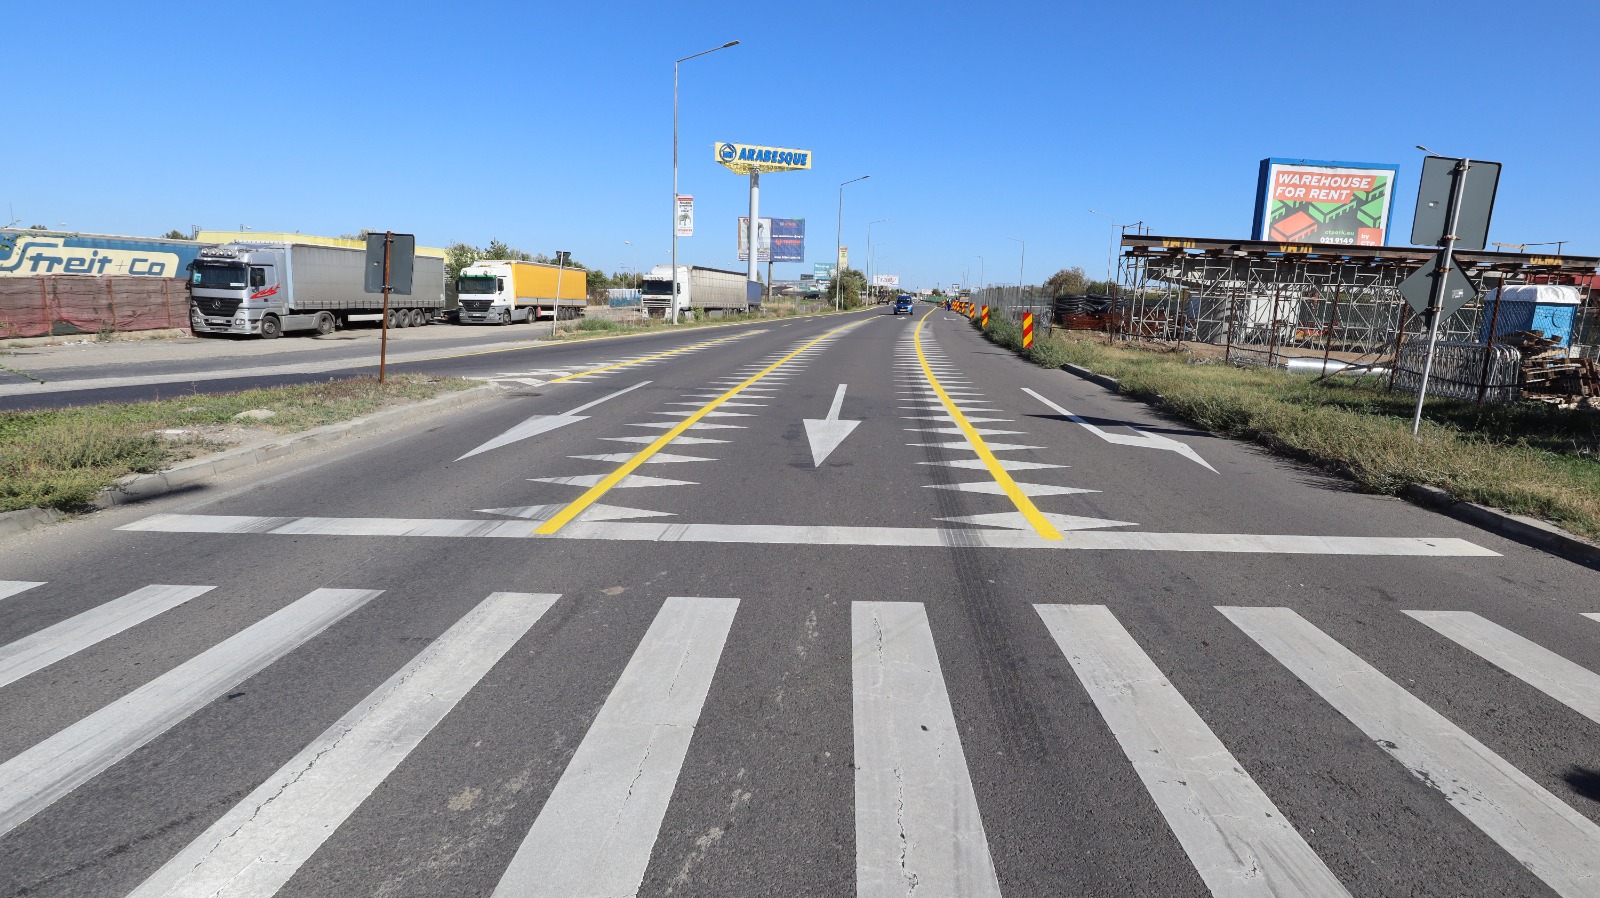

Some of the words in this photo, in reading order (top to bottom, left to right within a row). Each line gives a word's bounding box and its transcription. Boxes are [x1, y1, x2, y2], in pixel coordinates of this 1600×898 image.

[738, 147, 808, 166] ARABESQUE
[1278, 173, 1371, 189] WAREHOUSE
[1275, 186, 1306, 198] FOR
[1309, 189, 1350, 200] RENT
[1361, 233, 1370, 241] by
[128, 258, 166, 276] Co
